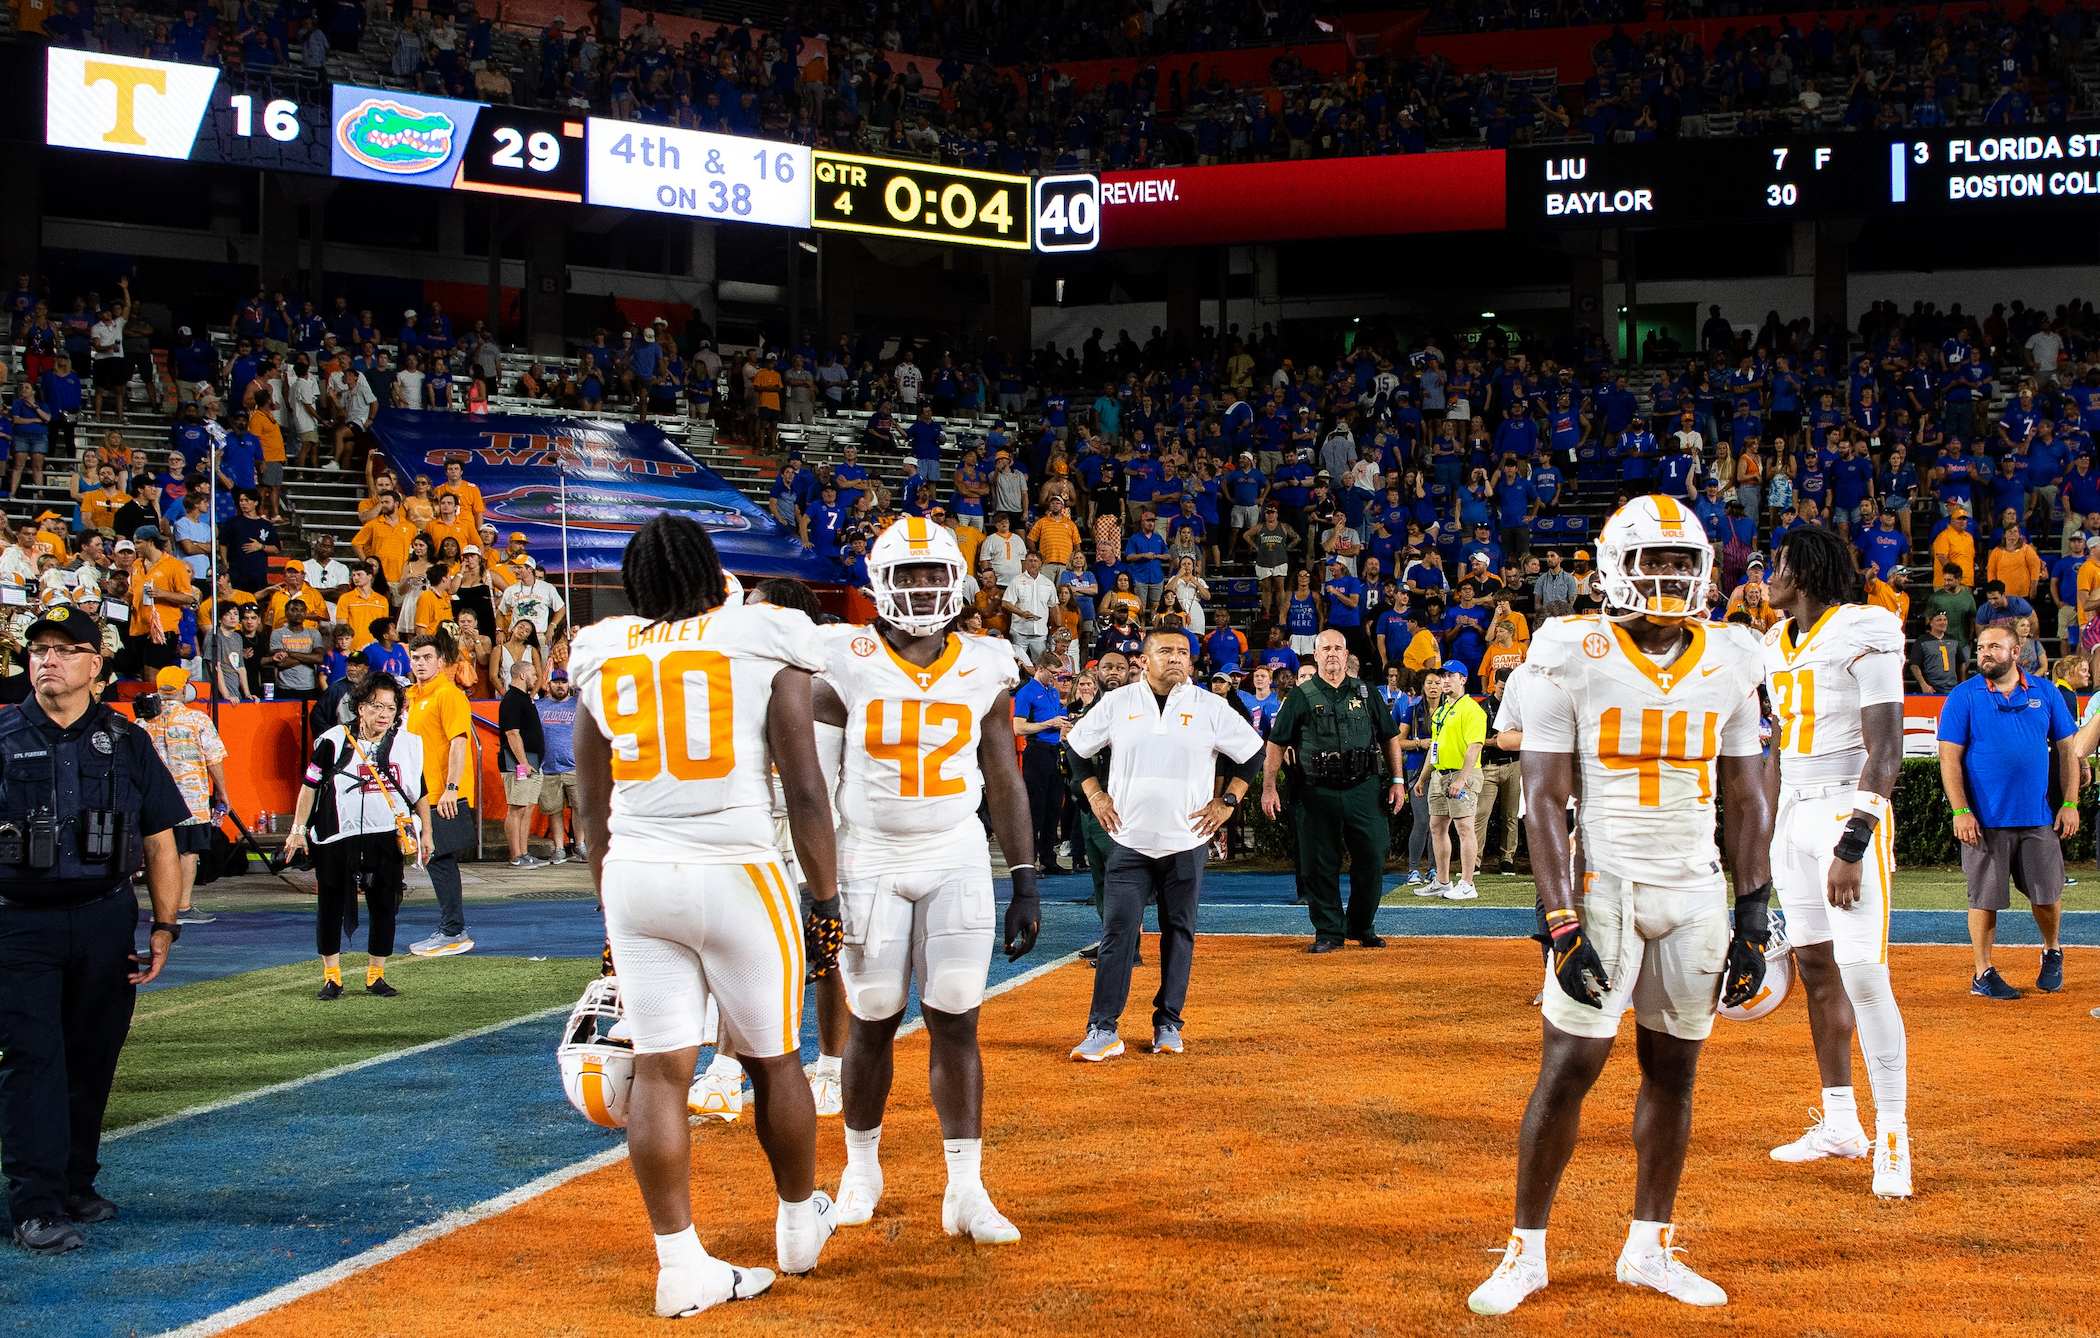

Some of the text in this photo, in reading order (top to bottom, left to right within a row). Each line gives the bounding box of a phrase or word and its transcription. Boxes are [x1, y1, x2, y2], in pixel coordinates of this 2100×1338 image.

[85, 60, 166, 146] T
[230, 94, 300, 142] 16
[491, 127, 561, 172] 29
[610, 133, 794, 183] 4th & 16
[1913, 141, 1930, 164] 3
[1949, 135, 2063, 164] FLORIDA
[815, 162, 867, 188] QTR
[1546, 148, 1832, 181] LIU 7 F
[657, 180, 752, 216] ON 38
[1101, 179, 1180, 206] REVIEW.
[1949, 173, 2044, 199] BOSTON
[833, 191, 853, 215] 4
[884, 176, 1012, 233] 0:04
[1546, 184, 1798, 215] BAYLOR 30
[1039, 193, 1094, 235] 40
[1378, 377, 1390, 391] 15
[1864, 411, 1872, 426] 1
[2023, 419, 2034, 436] 7
[479, 431, 619, 456] THE
[425, 447, 698, 478] SWAMP
[1669, 461, 1678, 478] 1
[827, 511, 839, 530] 7
[1265, 541, 1276, 552] T
[1662, 530, 1685, 538] VOLS
[910, 549, 931, 557] VOLS
[1005, 541, 1011, 560] 1
[627, 617, 711, 650] BAILEY
[1585, 636, 1607, 656] SEC
[853, 639, 875, 655] SEC
[1493, 654, 1521, 664] GAME
[1786, 652, 1796, 666] T
[1939, 645, 1950, 671] 1
[916, 671, 931, 688] T
[1656, 672, 1674, 691] T
[601, 650, 736, 782] 90
[1180, 713, 1194, 726] T
[1772, 669, 1817, 756] 31
[865, 699, 973, 797] 42
[1599, 706, 1720, 806] 44
